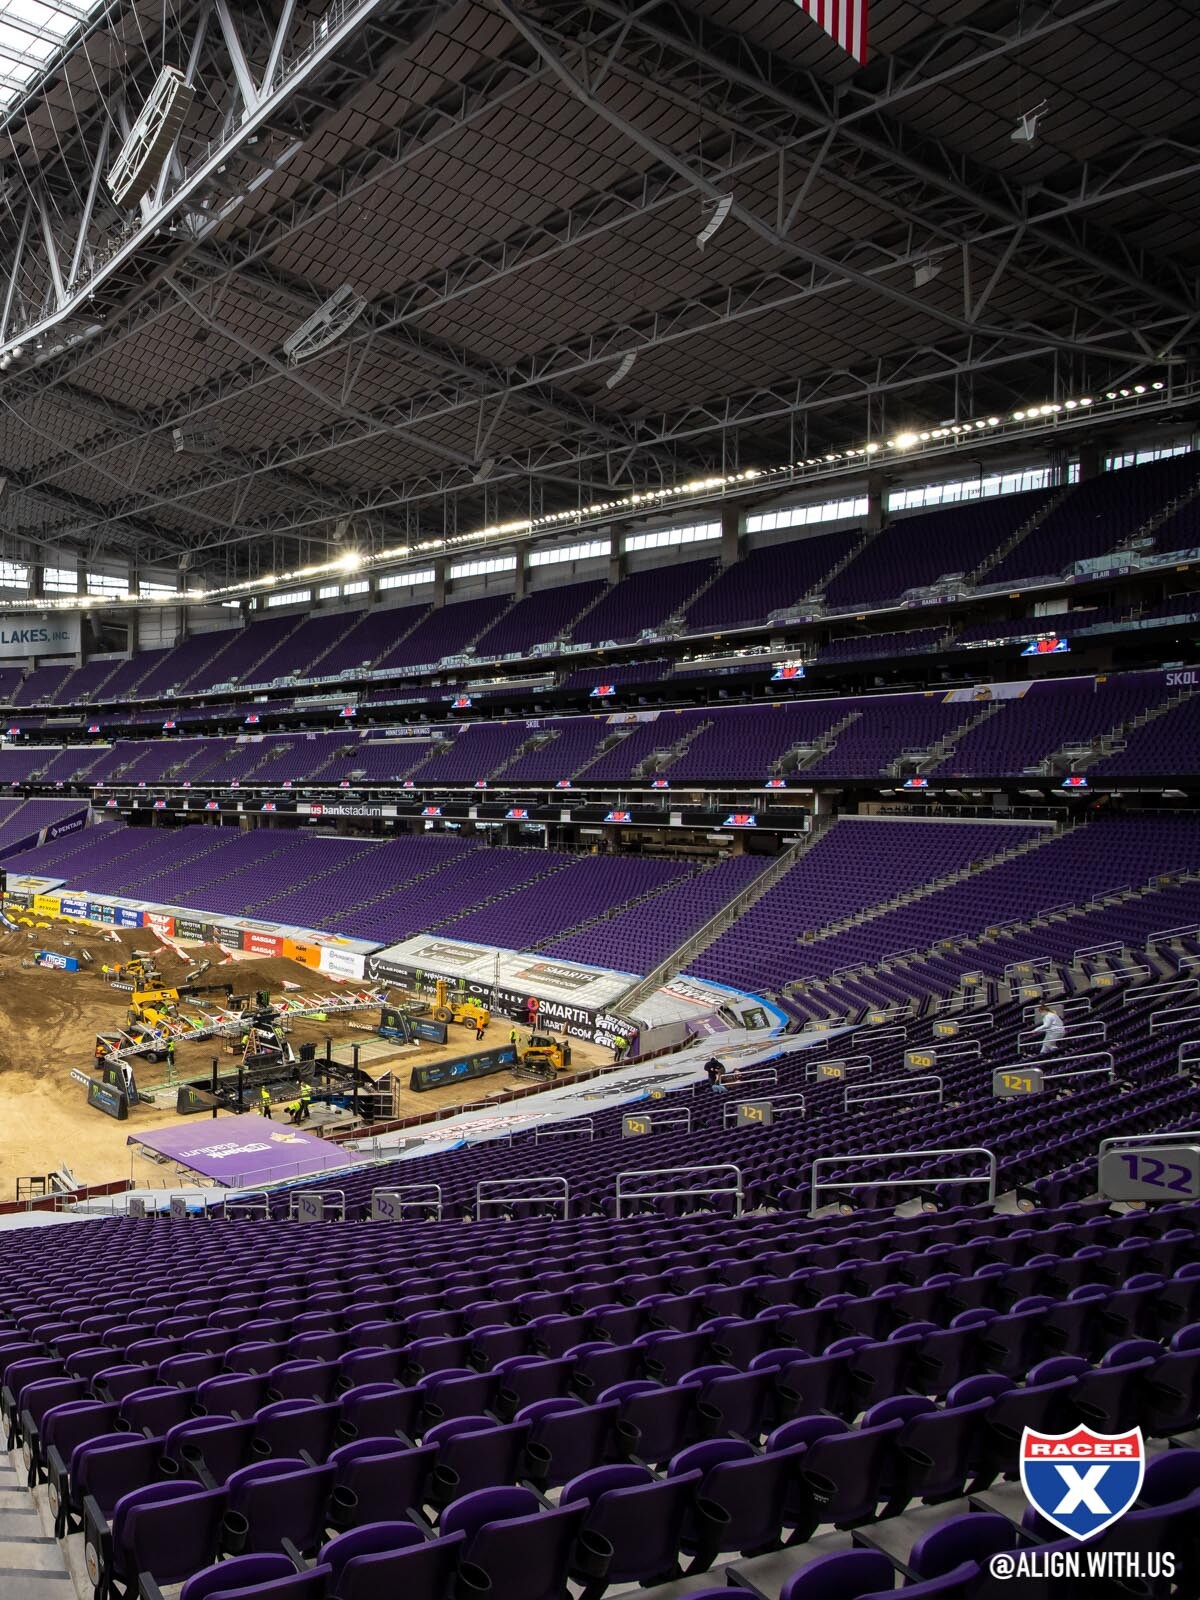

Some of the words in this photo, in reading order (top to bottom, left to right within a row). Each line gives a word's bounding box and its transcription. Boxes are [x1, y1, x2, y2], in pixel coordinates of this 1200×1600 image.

[52, 631, 70, 641] INC.
[1166, 671, 1199, 686] SKOL
[526, 720, 541, 729] SKOL
[385, 728, 408, 737] MINNESOTA
[413, 727, 430, 735] VIKINGS
[58, 820, 83, 834] PENTAIR
[251, 934, 276, 945] GASGAS
[423, 971, 457, 986] MONSTER
[483, 988, 524, 1004] OAKLEY
[909, 1055, 931, 1067] 120
[821, 1066, 841, 1078] 120
[1002, 1075, 1032, 1093] 121
[742, 1105, 763, 1121] 121
[627, 1119, 645, 1133] 121
[1120, 1154, 1193, 1194] 122
[302, 1201, 318, 1217] 122
[376, 1197, 395, 1218] 122
